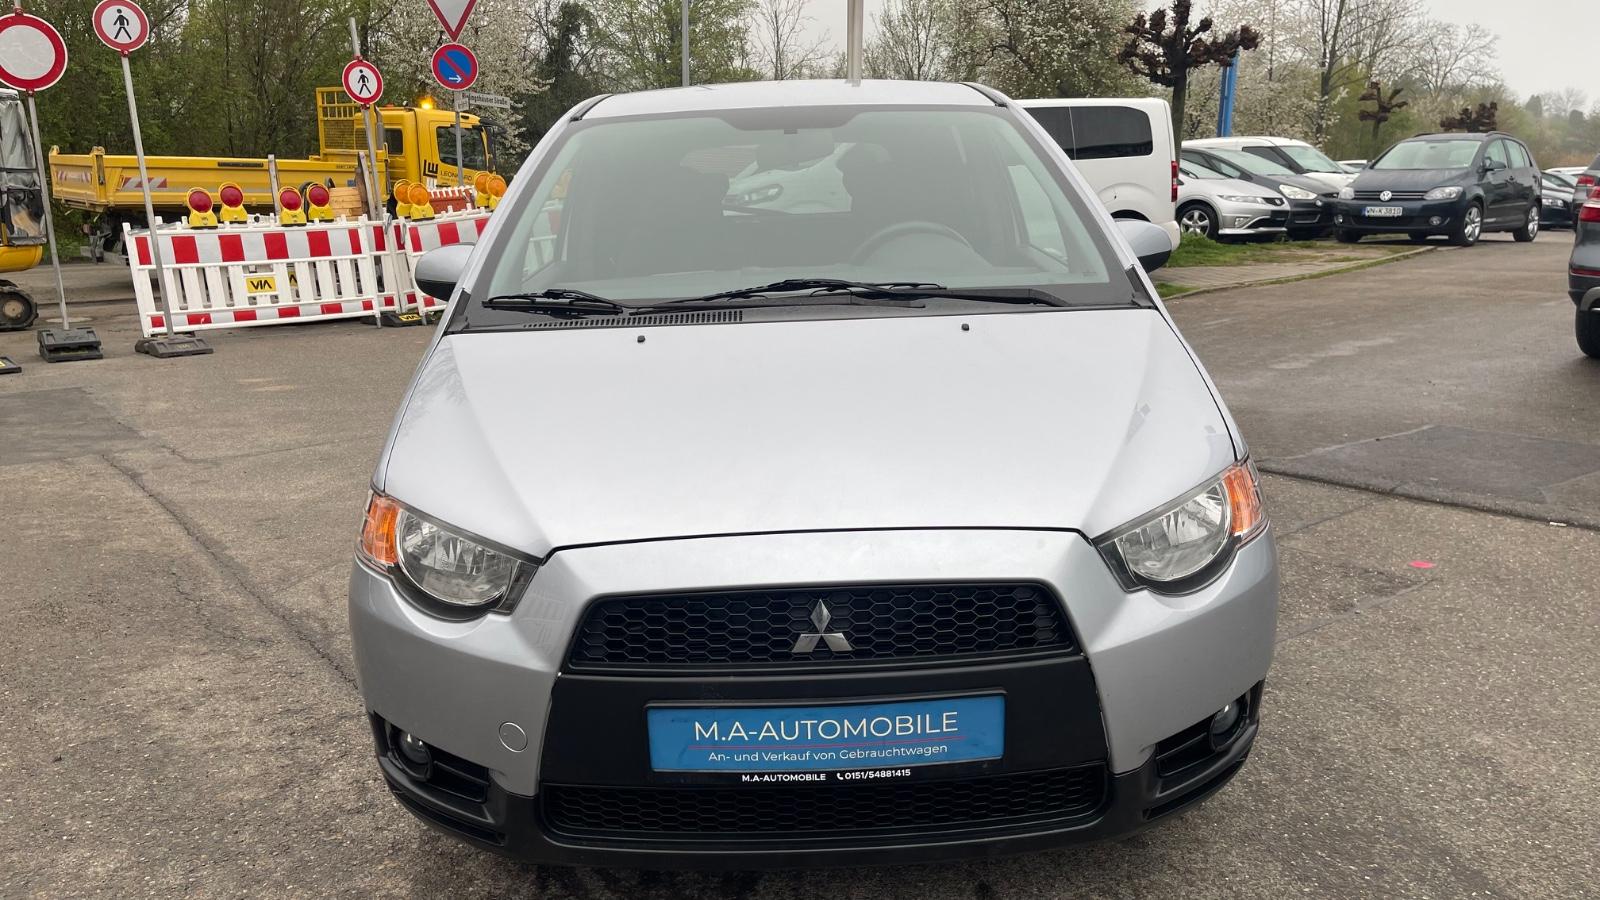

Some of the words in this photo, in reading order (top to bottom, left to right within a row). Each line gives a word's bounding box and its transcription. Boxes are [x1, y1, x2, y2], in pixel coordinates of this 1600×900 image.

[250, 279, 273, 290] VIA
[694, 711, 959, 741] M.A-AUTOMOBILE
[708, 752, 731, 762] An-
[734, 752, 760, 762] und
[761, 751, 811, 761] Verkauf
[812, 751, 837, 760] von
[839, 745, 948, 760] Gebrauchtwagen
[741, 773, 827, 782] M.A-AUTOMOBILE
[844, 768, 911, 780] 0151/54881415
